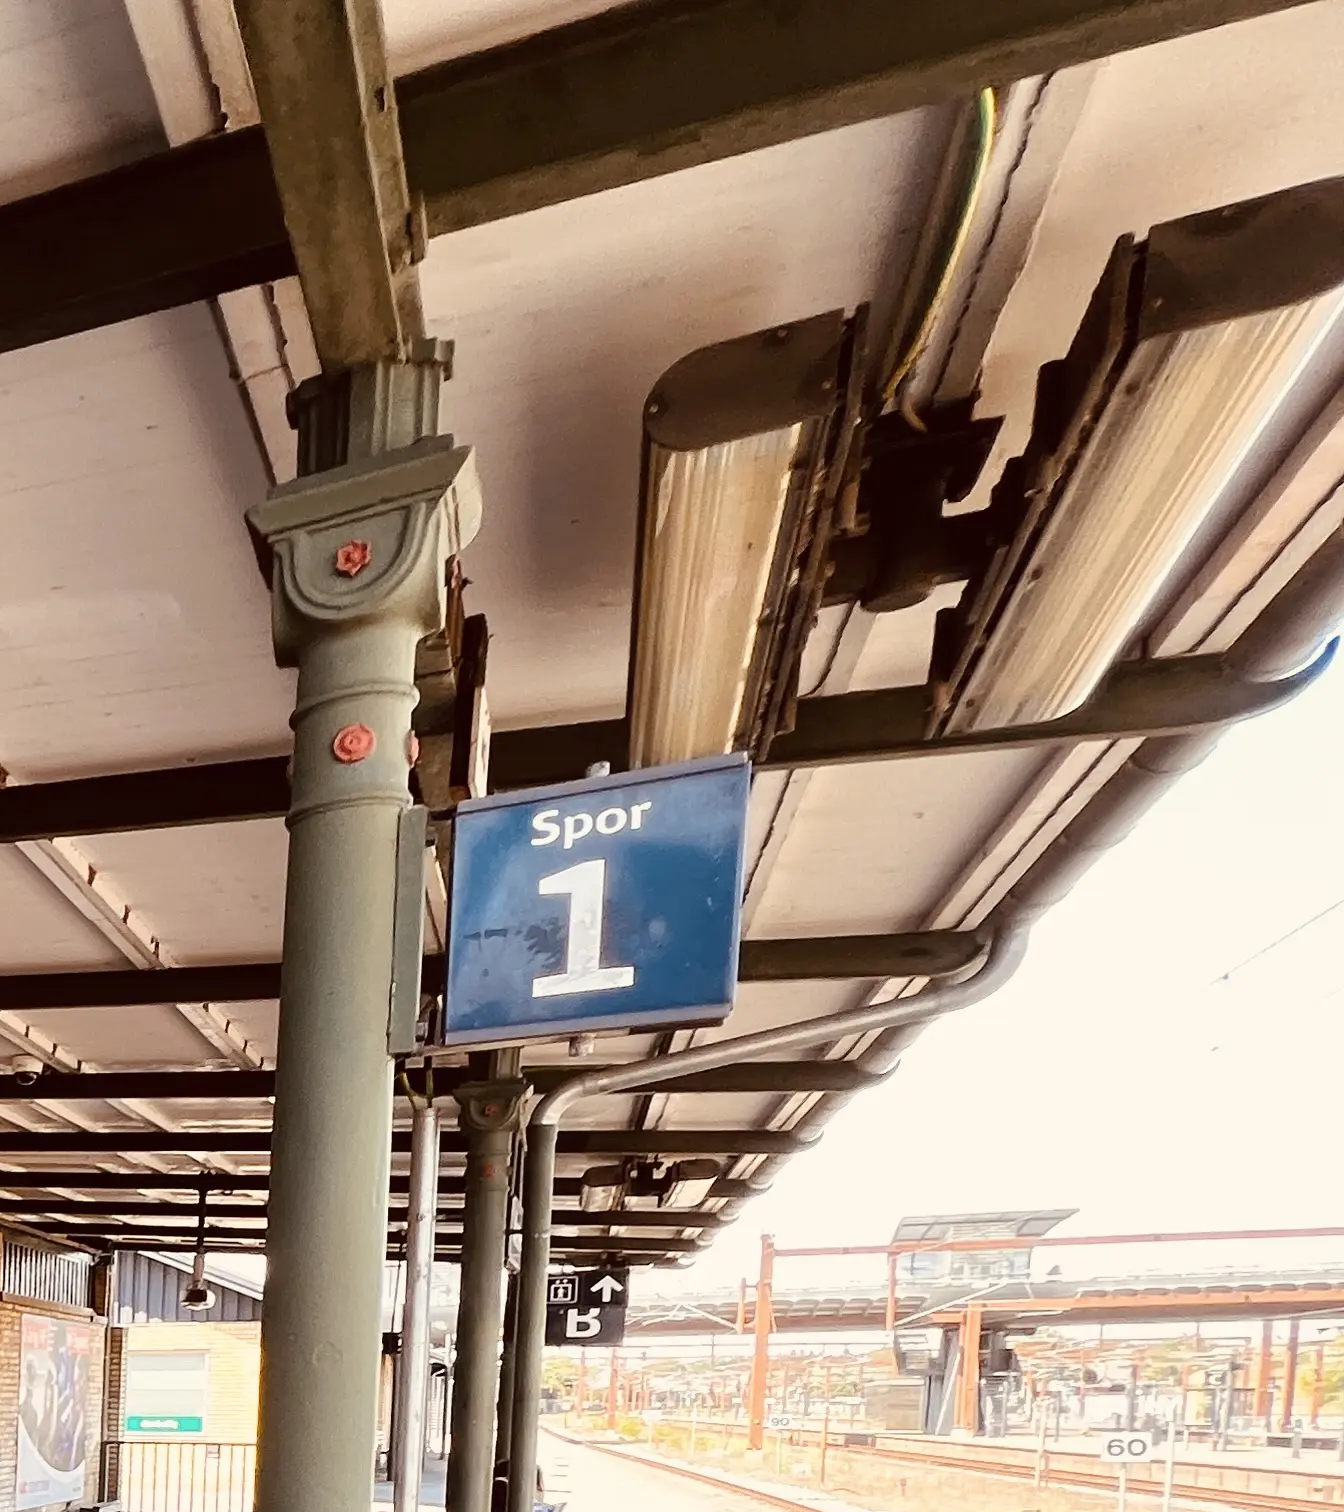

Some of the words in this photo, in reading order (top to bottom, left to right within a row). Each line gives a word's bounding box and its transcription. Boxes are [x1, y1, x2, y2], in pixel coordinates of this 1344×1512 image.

[531, 801, 652, 849] Spor
[532, 859, 635, 998] 1
[1107, 1439, 1147, 1456] 60
